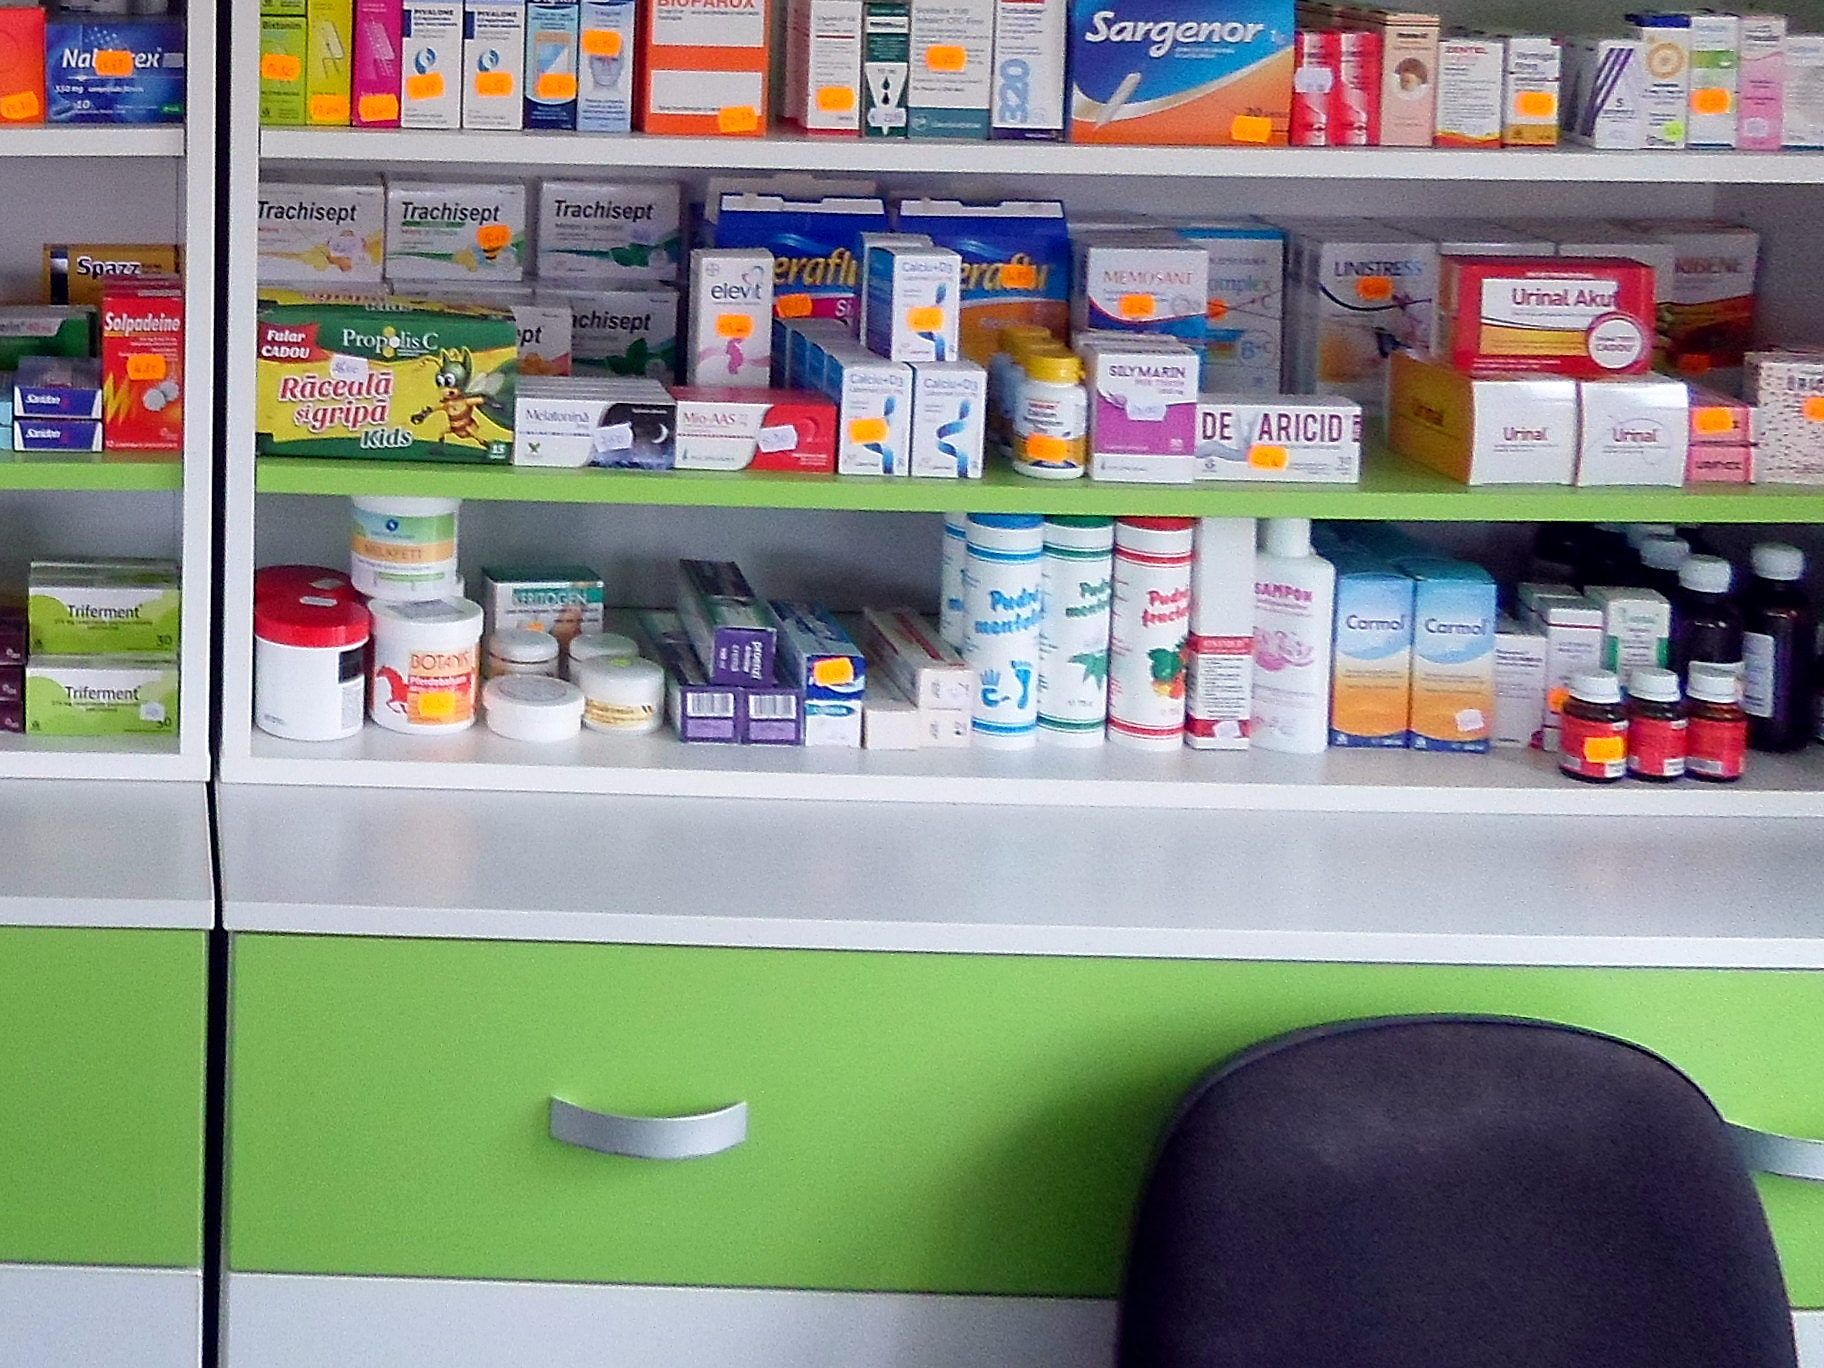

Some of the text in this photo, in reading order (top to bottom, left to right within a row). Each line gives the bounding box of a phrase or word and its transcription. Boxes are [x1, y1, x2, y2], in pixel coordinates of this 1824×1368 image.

[1086, 11, 1265, 58] Sargenor
[258, 200, 357, 224] Trachisept
[402, 201, 500, 224] Trachisept
[555, 200, 653, 222] Trachisept
[711, 283, 761, 300] elevit
[1512, 288, 1569, 306] Urinal
[105, 313, 180, 334] Solpadeine
[267, 331, 306, 344] Fular
[423, 333, 439, 350] C
[262, 345, 309, 359] CADOU
[1109, 365, 1186, 379] SILYMARIN
[683, 412, 735, 425] Mio-AAS
[361, 429, 412, 450] Kids
[1503, 428, 1548, 442] Urinal
[1613, 428, 1657, 442] Urinal
[68, 604, 140, 620] Triferment
[1346, 615, 1406, 632] Carmol
[1425, 618, 1484, 635] Carmol
[65, 686, 138, 701] Triferment
